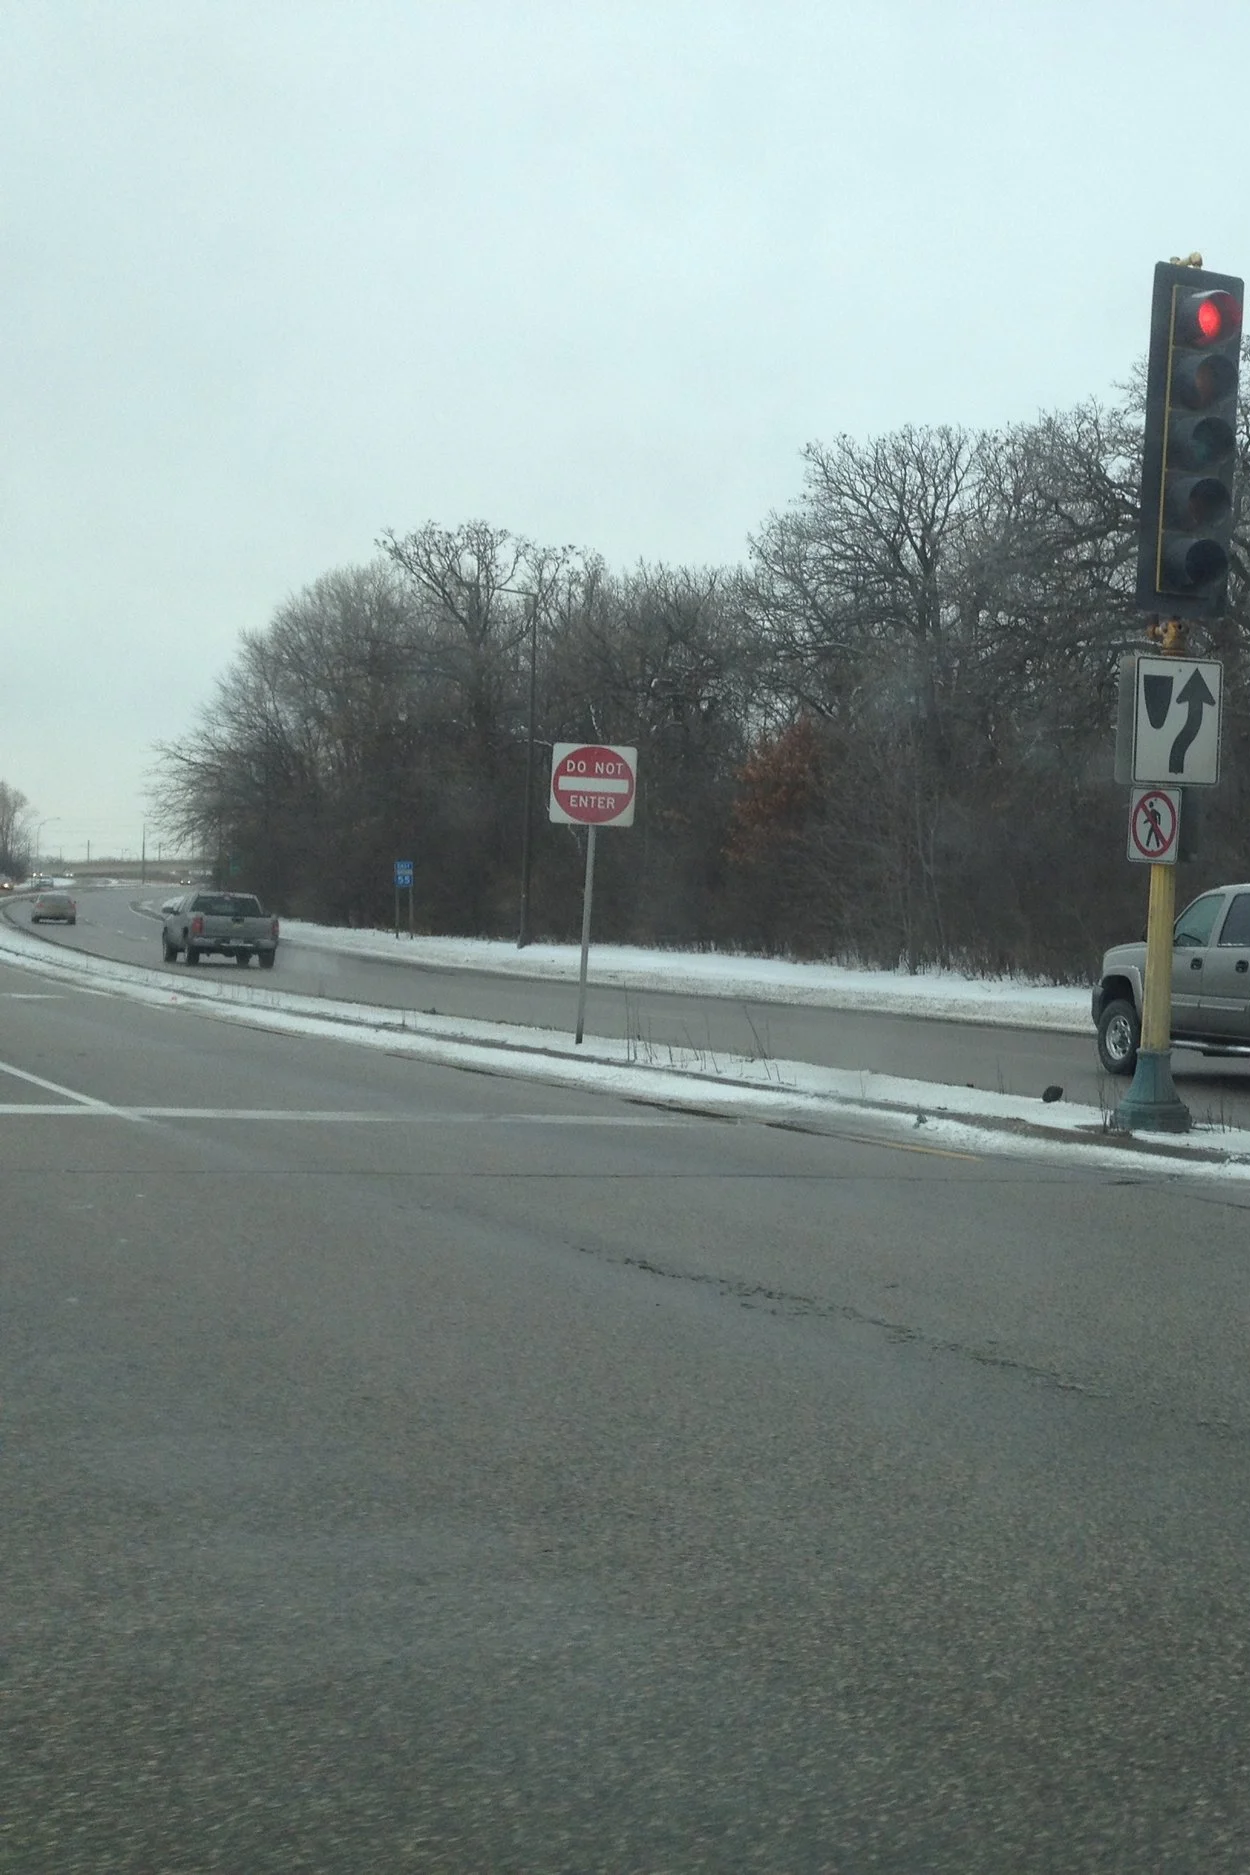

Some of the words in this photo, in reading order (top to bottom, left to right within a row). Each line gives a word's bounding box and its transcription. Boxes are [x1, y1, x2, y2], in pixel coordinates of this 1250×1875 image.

[566, 759, 587, 773] DO
[595, 761, 624, 776] NOT
[569, 794, 616, 810] ENTER
